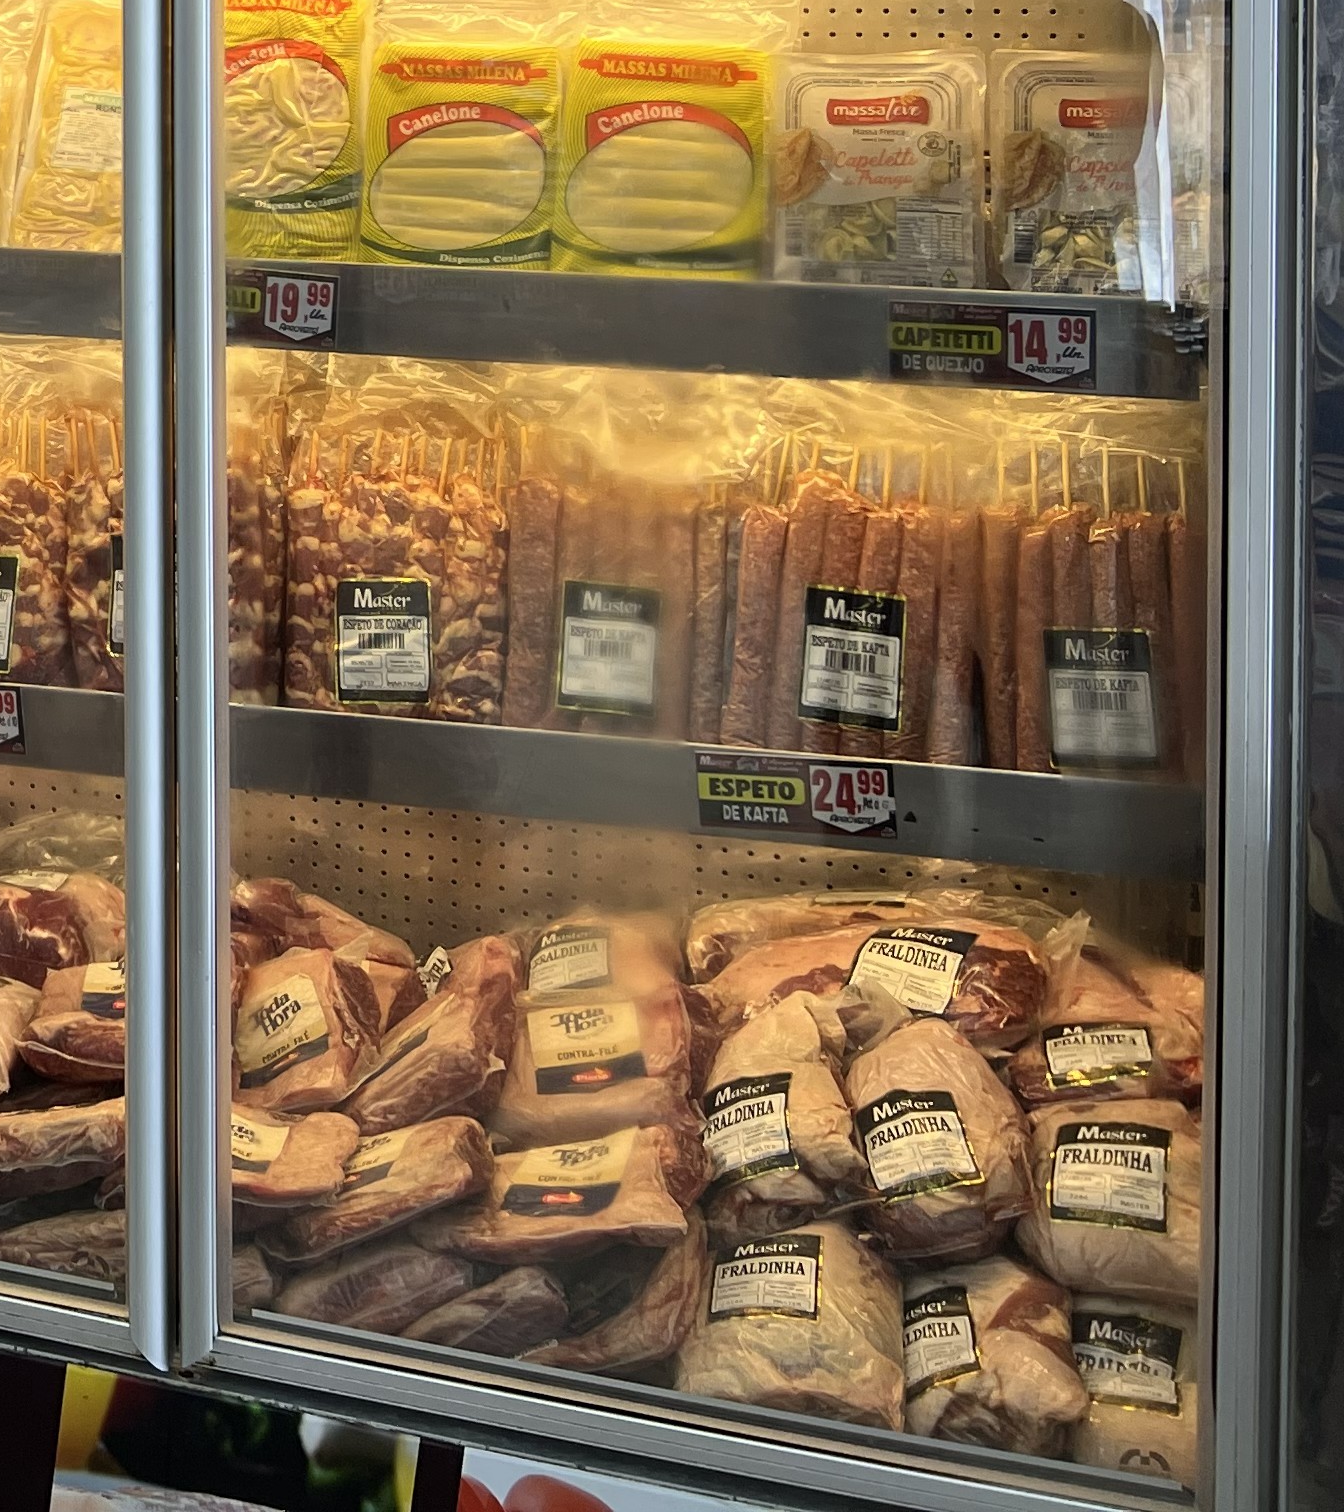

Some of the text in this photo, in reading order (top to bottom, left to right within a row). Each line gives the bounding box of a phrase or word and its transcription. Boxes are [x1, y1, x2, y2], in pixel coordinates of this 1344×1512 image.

[402, 63, 526, 82] MASSAS MILENA
[602, 59, 666, 78] MASSAS
[399, 104, 481, 136] Canelone
[597, 104, 683, 134] Canelone
[439, 253, 489, 264] Dispensa
[893, 326, 994, 351] CAPETETTI
[902, 354, 984, 374] DE QUEIJO
[354, 588, 411, 608] Master
[824, 597, 886, 626] Master
[811, 635, 846, 648] ESPETO
[862, 641, 890, 657] KAFTA
[1055, 678, 1139, 691] ESPETO DE KAFTA
[708, 778, 795, 800] ESPETO
[723, 804, 788, 823] DE KAFTA
[890, 927, 953, 945] Master
[868, 940, 951, 972] FRALDINHA
[714, 1081, 769, 1107] Master
[870, 1115, 952, 1150] FRALDINHA
[1062, 1148, 1152, 1173] FRALDINHA
[721, 1261, 805, 1279] FRALDINHA
